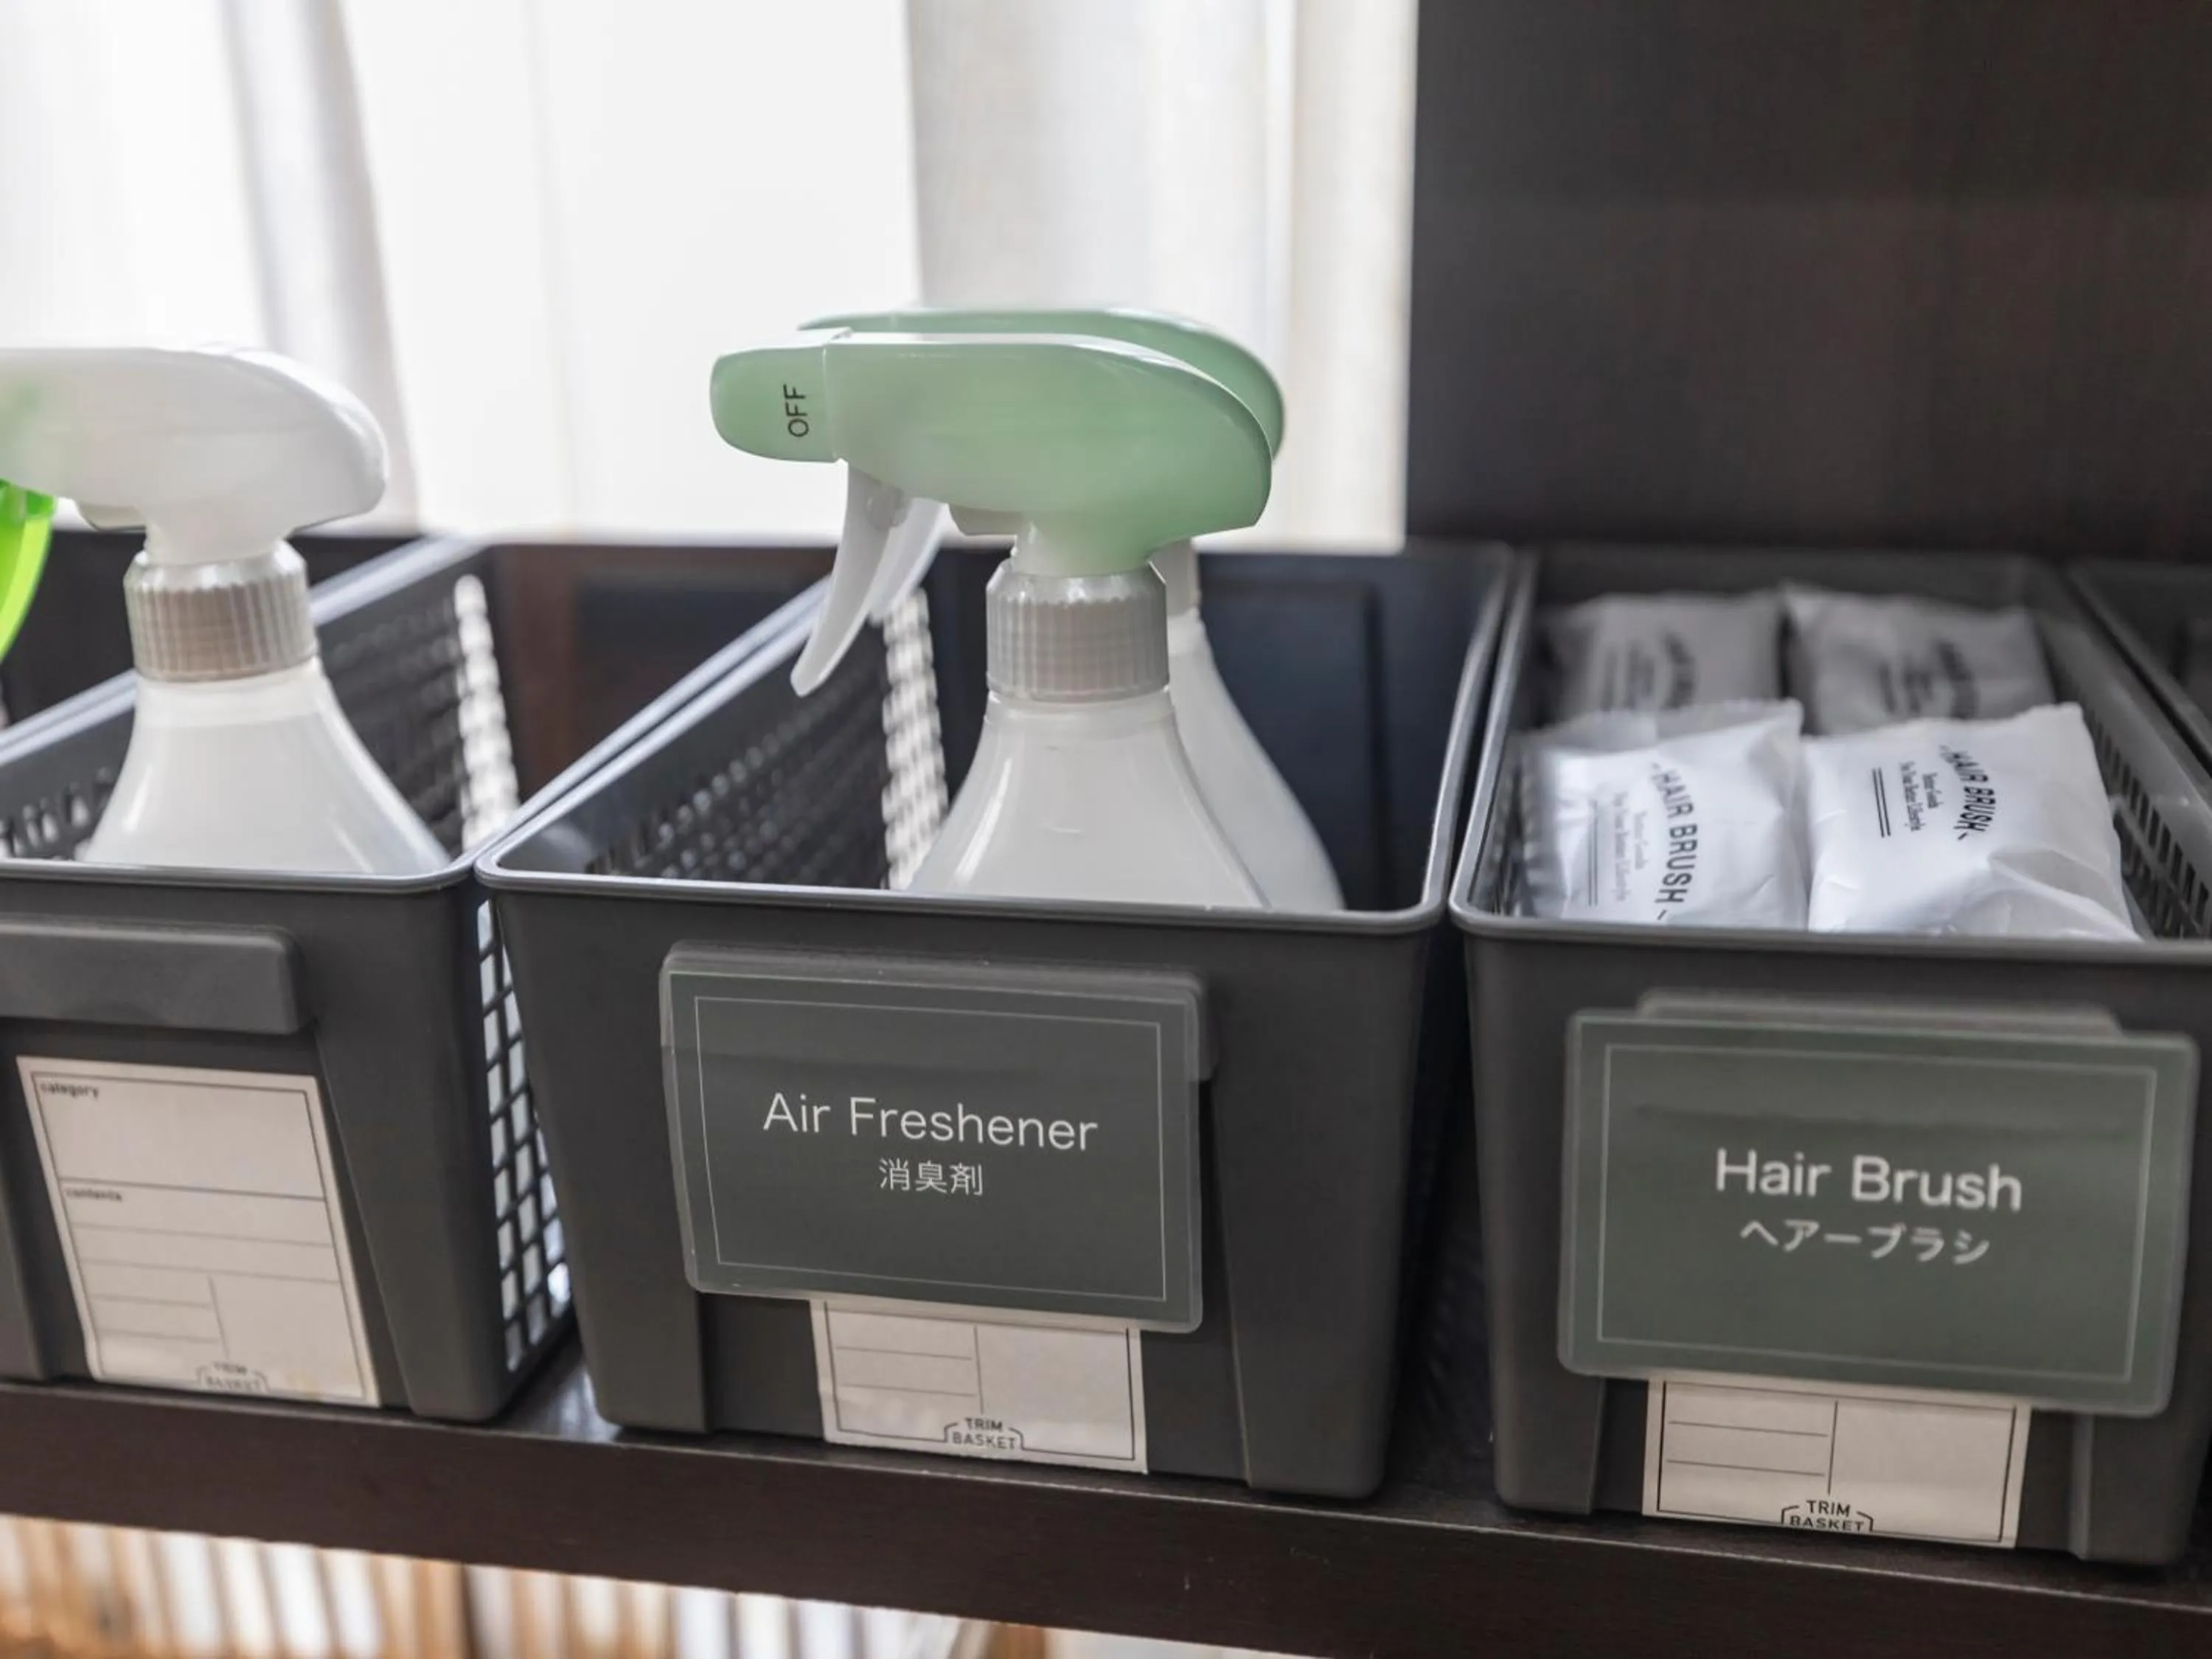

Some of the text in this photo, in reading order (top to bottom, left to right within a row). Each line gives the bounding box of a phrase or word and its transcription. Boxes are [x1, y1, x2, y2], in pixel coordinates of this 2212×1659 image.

[782, 383, 809, 437] OFF
[1952, 786, 1996, 832] BRUSH
[1651, 769, 1698, 903] HAIR BRUSH
[762, 1092, 1098, 1151] Air Freshener
[879, 1158, 984, 1196] 消臭剤
[1717, 1147, 2023, 1213] Hair Brush
[1739, 1219, 1990, 1265] ヘアーブラシ
[952, 1431, 1015, 1449] BASKET
[964, 1417, 1003, 1431] TRIM
[1790, 1515, 1865, 1531] BASKET
[1806, 1499, 1851, 1517] TRIM
